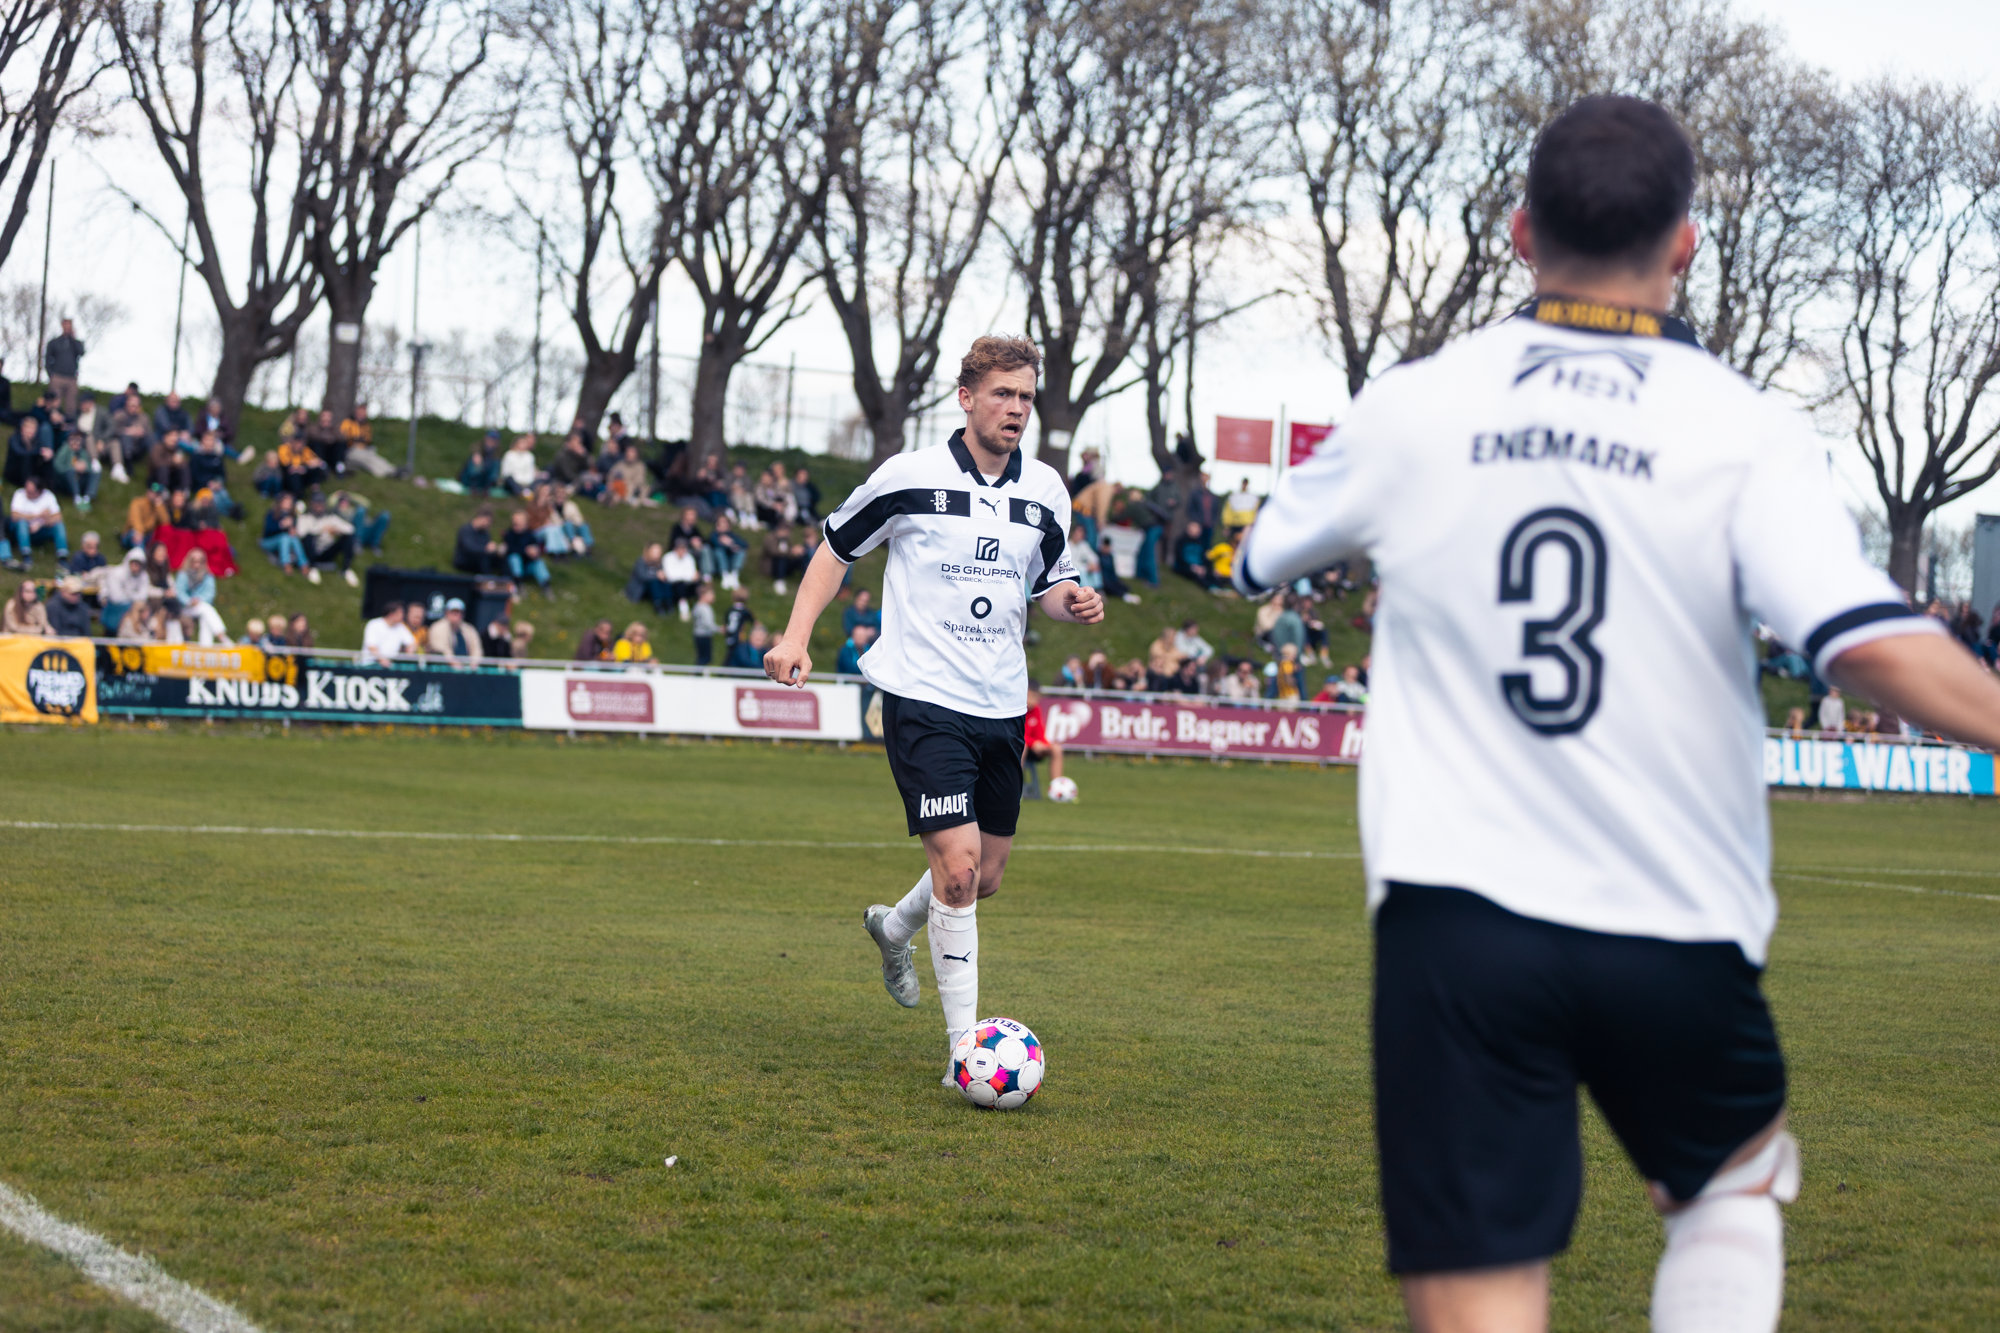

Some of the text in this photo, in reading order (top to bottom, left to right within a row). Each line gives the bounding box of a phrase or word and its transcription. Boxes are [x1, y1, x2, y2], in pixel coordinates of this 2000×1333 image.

[1472, 426, 1656, 480] ENEMARK
[933, 490, 947, 501] 19
[933, 501, 947, 512] 13
[941, 563, 1021, 580] DS GRUPPEN
[945, 574, 982, 583] GOLDBECK
[943, 619, 1006, 635] Sparekassen
[1500, 506, 1607, 736] 3
[1100, 706, 1320, 752] Brdr. Bagner A/S
[1764, 738, 1973, 794] BLUE WATER
